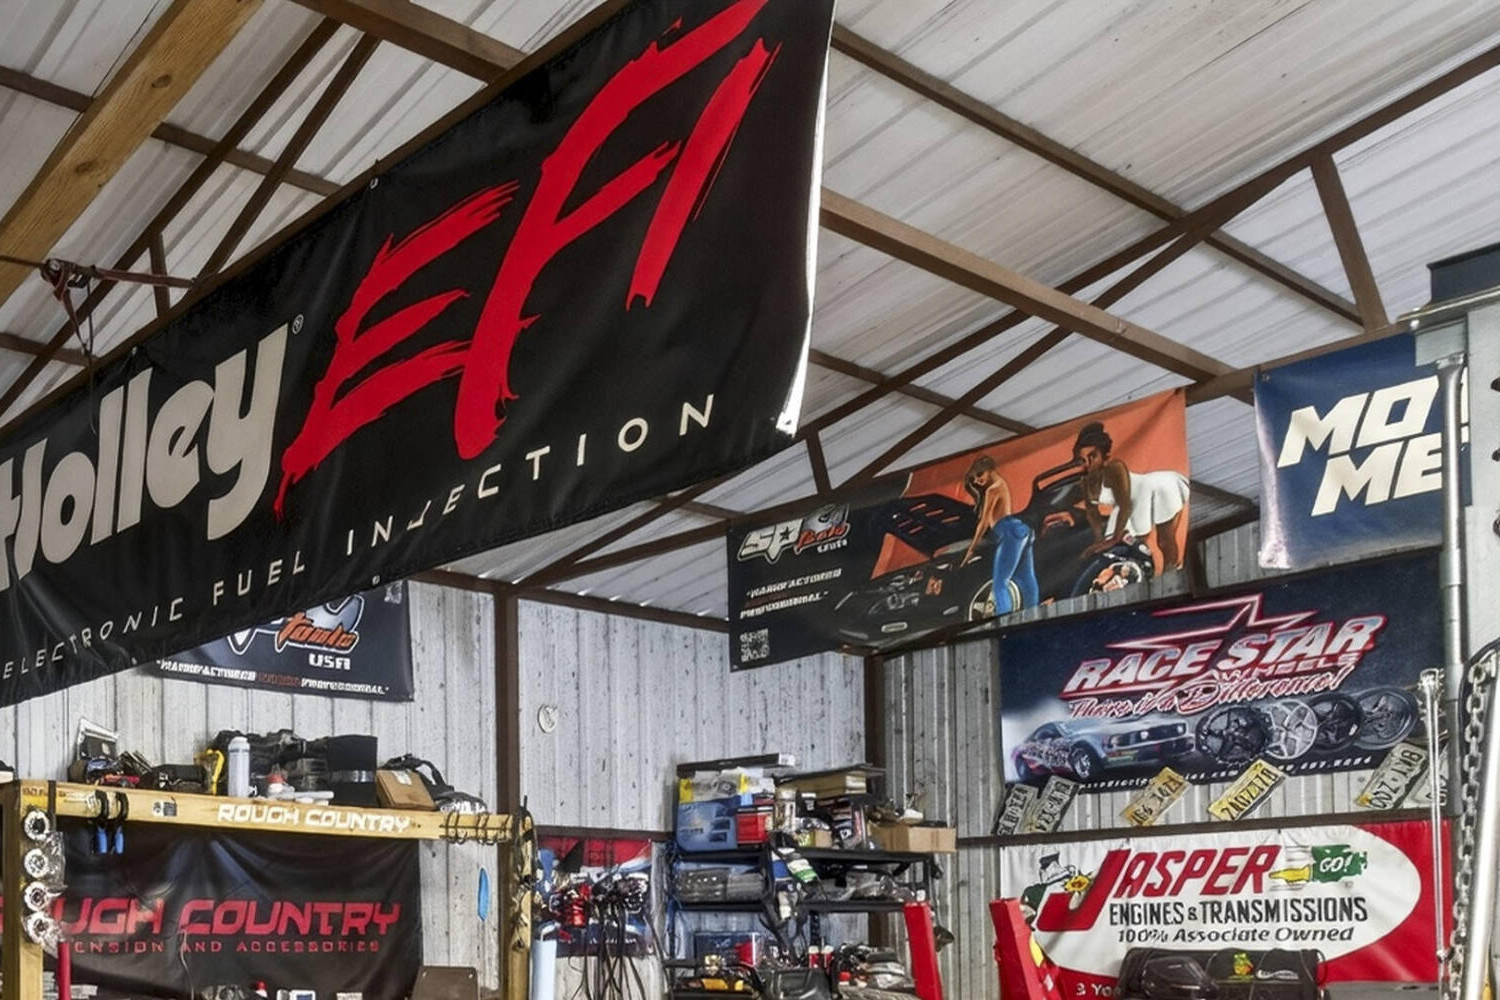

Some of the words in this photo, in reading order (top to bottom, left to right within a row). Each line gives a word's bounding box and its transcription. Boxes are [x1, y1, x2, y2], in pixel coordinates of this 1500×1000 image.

[275, 0, 781, 522] EFI
[1277, 374, 1468, 468] MO
[2, 597, 184, 681] ELECTRONIC
[213, 551, 305, 605] FUEL
[344, 394, 716, 555] INJECTION
[308, 653, 351, 670] USA
[1062, 639, 1223, 693] RACE
[1217, 614, 1387, 671] STAR
[217, 804, 300, 825] ROUGH
[305, 808, 412, 834] COUNTRY
[1037, 845, 1283, 932] JASPER
[1320, 855, 1353, 873] GO!
[178, 899, 401, 936] COUNTRY
[1109, 901, 1184, 926] ENGINES
[1199, 897, 1368, 925] TRANSMISSIONS
[182, 941, 222, 953] AND
[236, 941, 381, 954] ACCESSORIES
[1117, 929, 1167, 943] 100%
[1173, 928, 1270, 943] Associate
[1274, 927, 1354, 943] Owned
